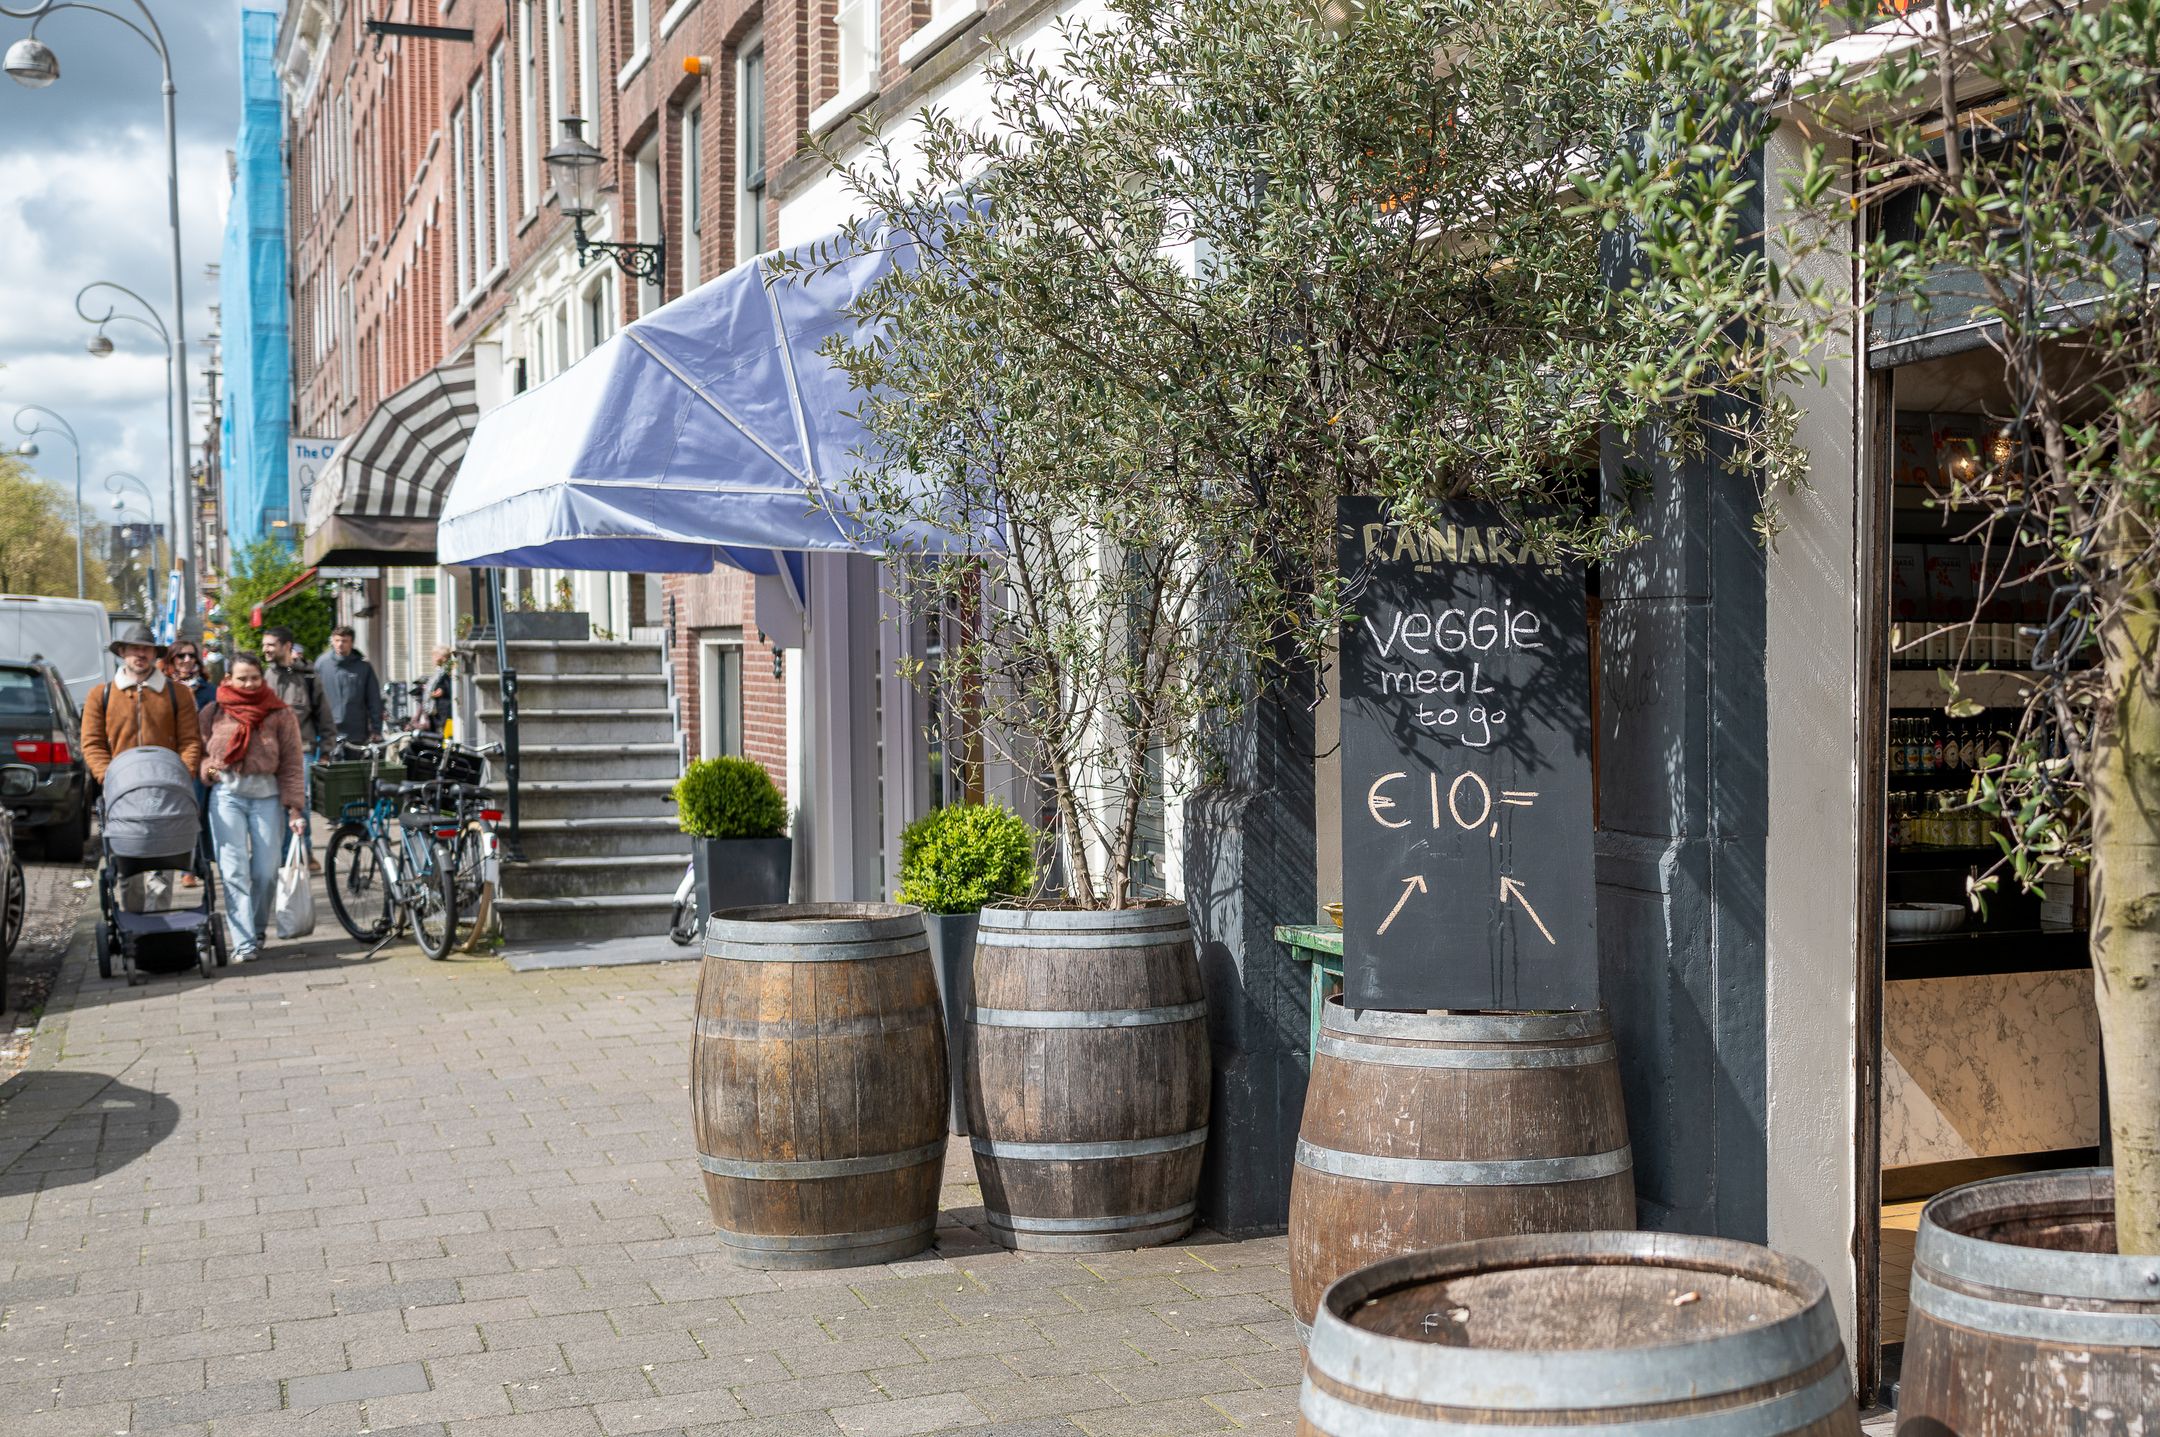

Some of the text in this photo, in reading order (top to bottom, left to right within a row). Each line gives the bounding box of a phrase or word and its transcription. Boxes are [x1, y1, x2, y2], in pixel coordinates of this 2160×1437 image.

[296, 445, 318, 459] The
[1415, 702, 1508, 748] to go
